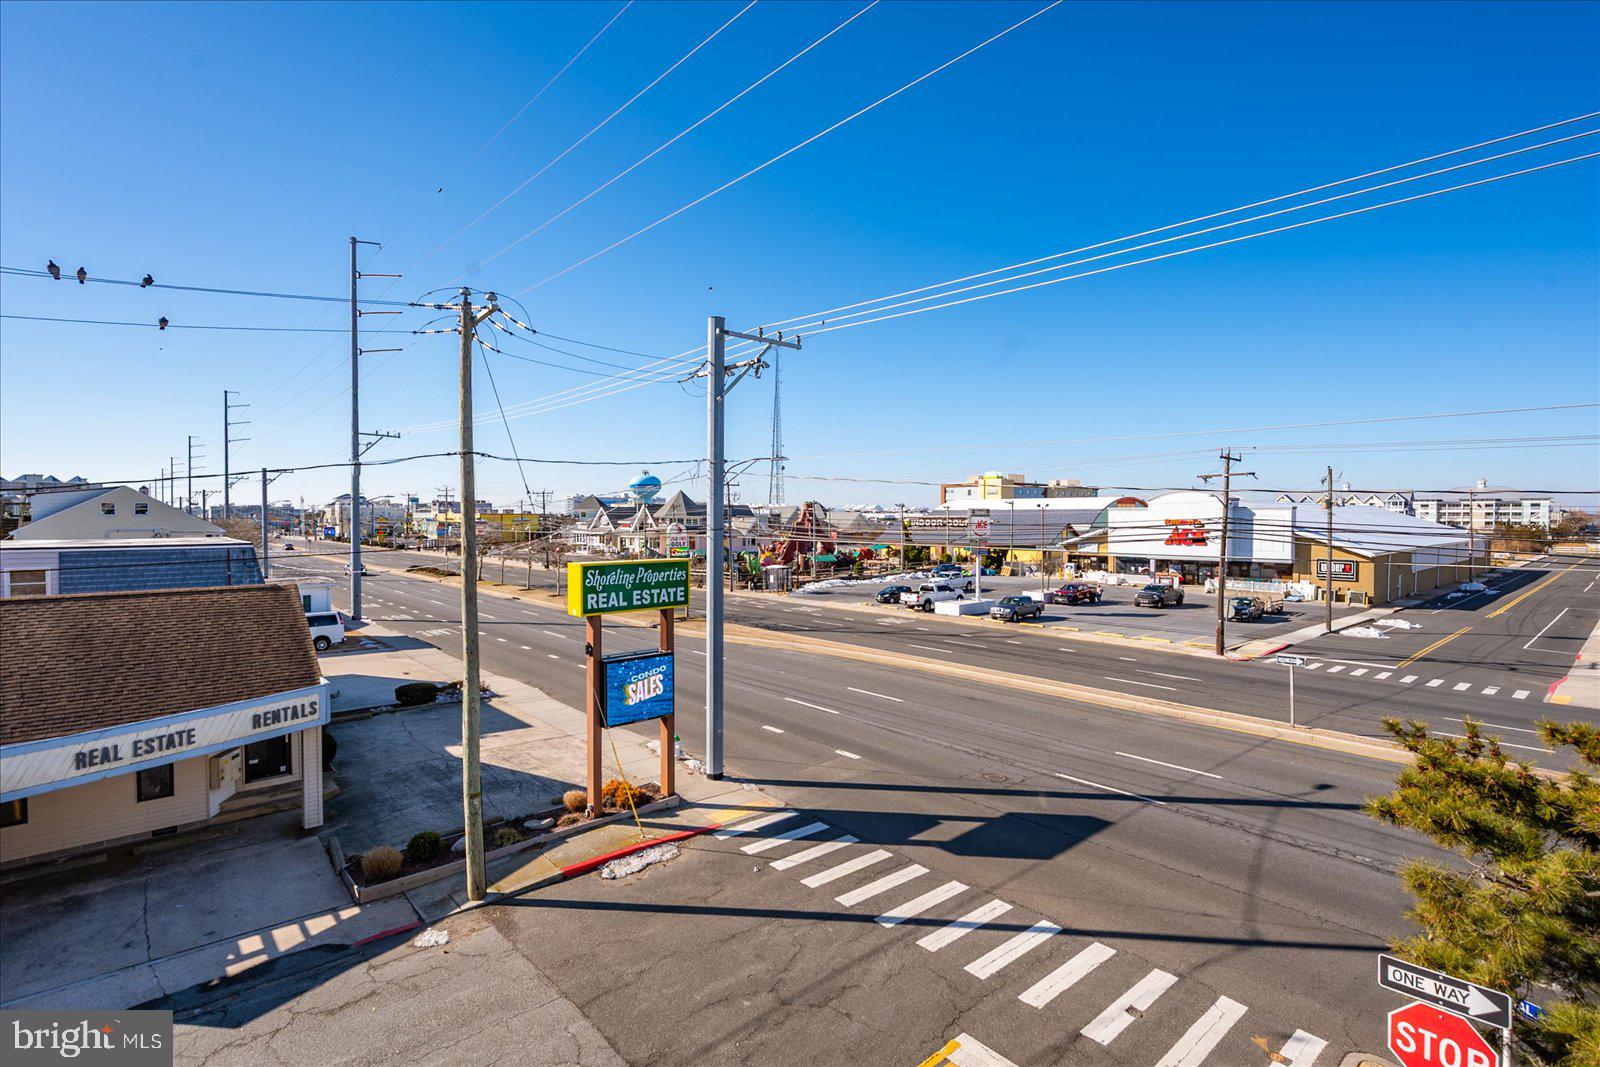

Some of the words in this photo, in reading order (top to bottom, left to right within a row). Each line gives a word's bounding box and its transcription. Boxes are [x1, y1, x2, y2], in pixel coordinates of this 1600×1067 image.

[1164, 527, 1210, 546] ACE
[585, 568, 635, 591] Shoreline
[636, 567, 686, 585] Properties
[587, 592, 627, 609] REAL
[633, 587, 685, 605] ESTATE
[631, 665, 666, 682] CONDO
[627, 674, 664, 705] SALES
[252, 701, 318, 729] RENTALS
[75, 744, 123, 770] REAL
[132, 728, 196, 757] ESTATE
[1393, 969, 1425, 990] ONE
[1434, 982, 1470, 1004] WAY
